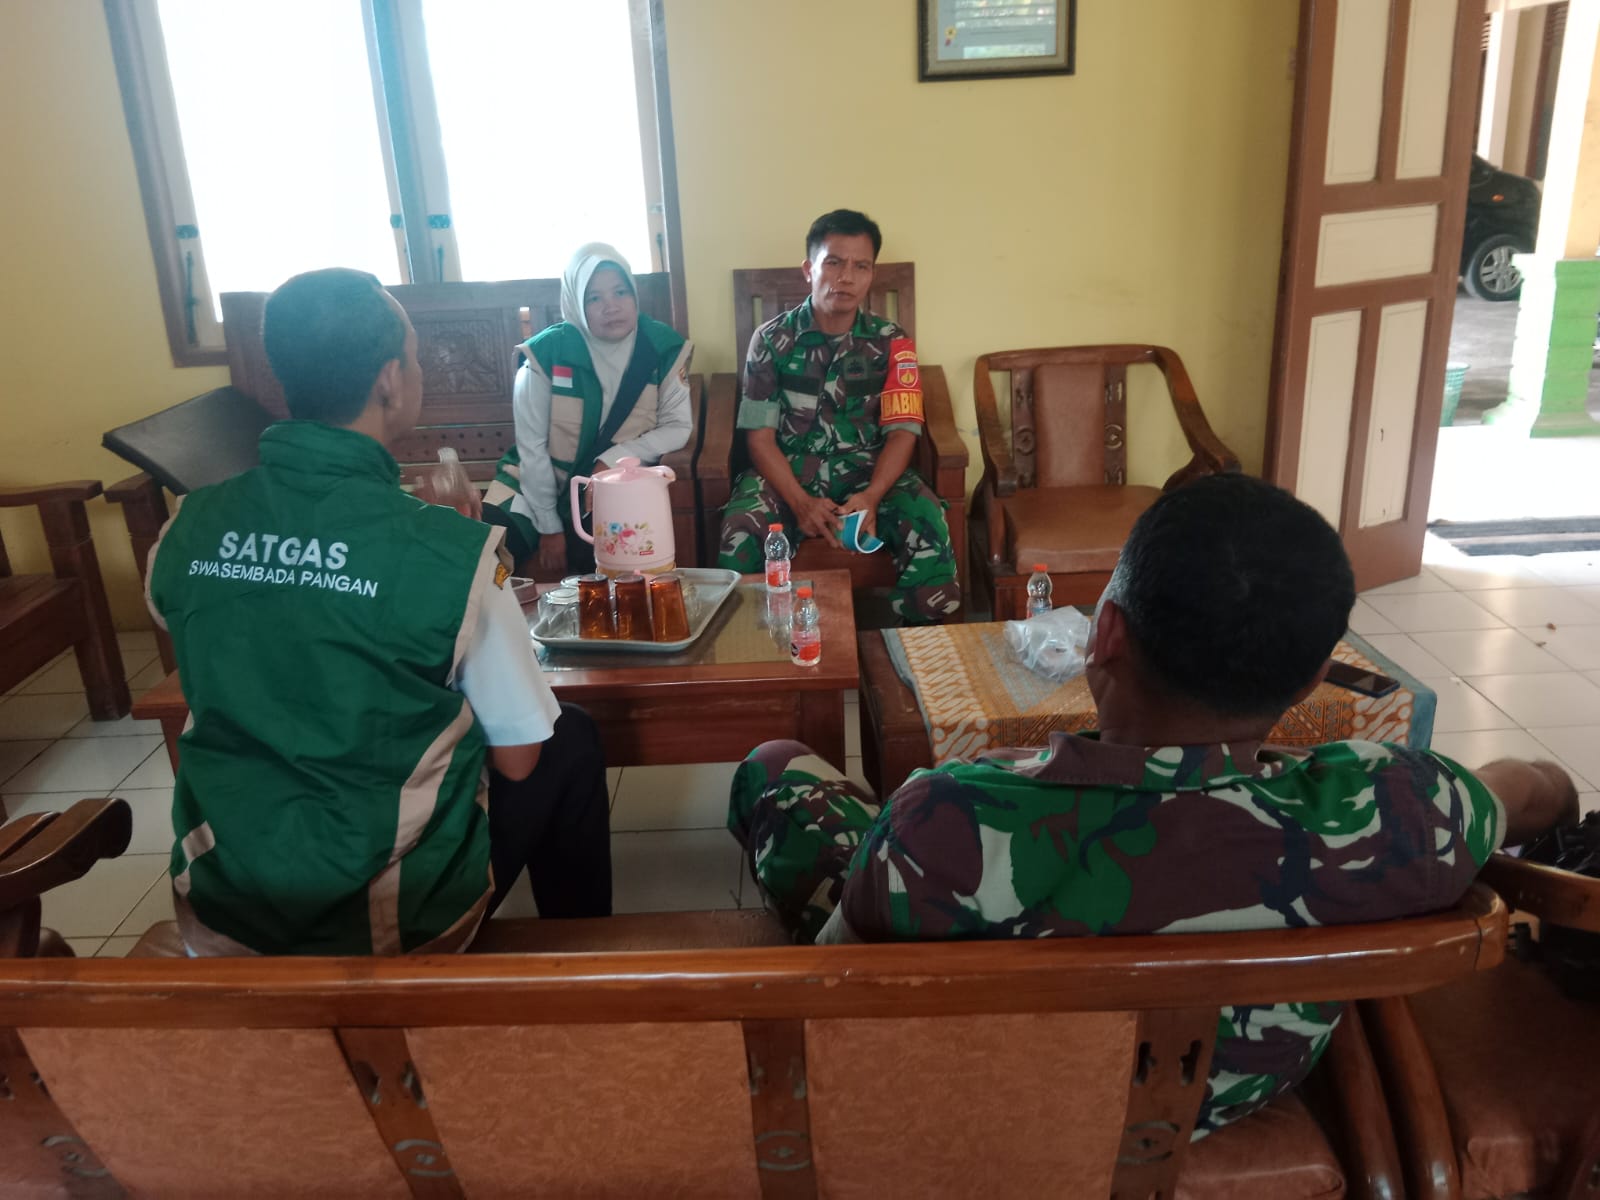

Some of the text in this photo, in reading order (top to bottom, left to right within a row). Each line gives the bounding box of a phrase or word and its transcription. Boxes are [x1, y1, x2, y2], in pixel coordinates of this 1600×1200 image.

[218, 531, 349, 570] SATGAS
[189, 560, 379, 598] SWASEMBADA PANGAN
